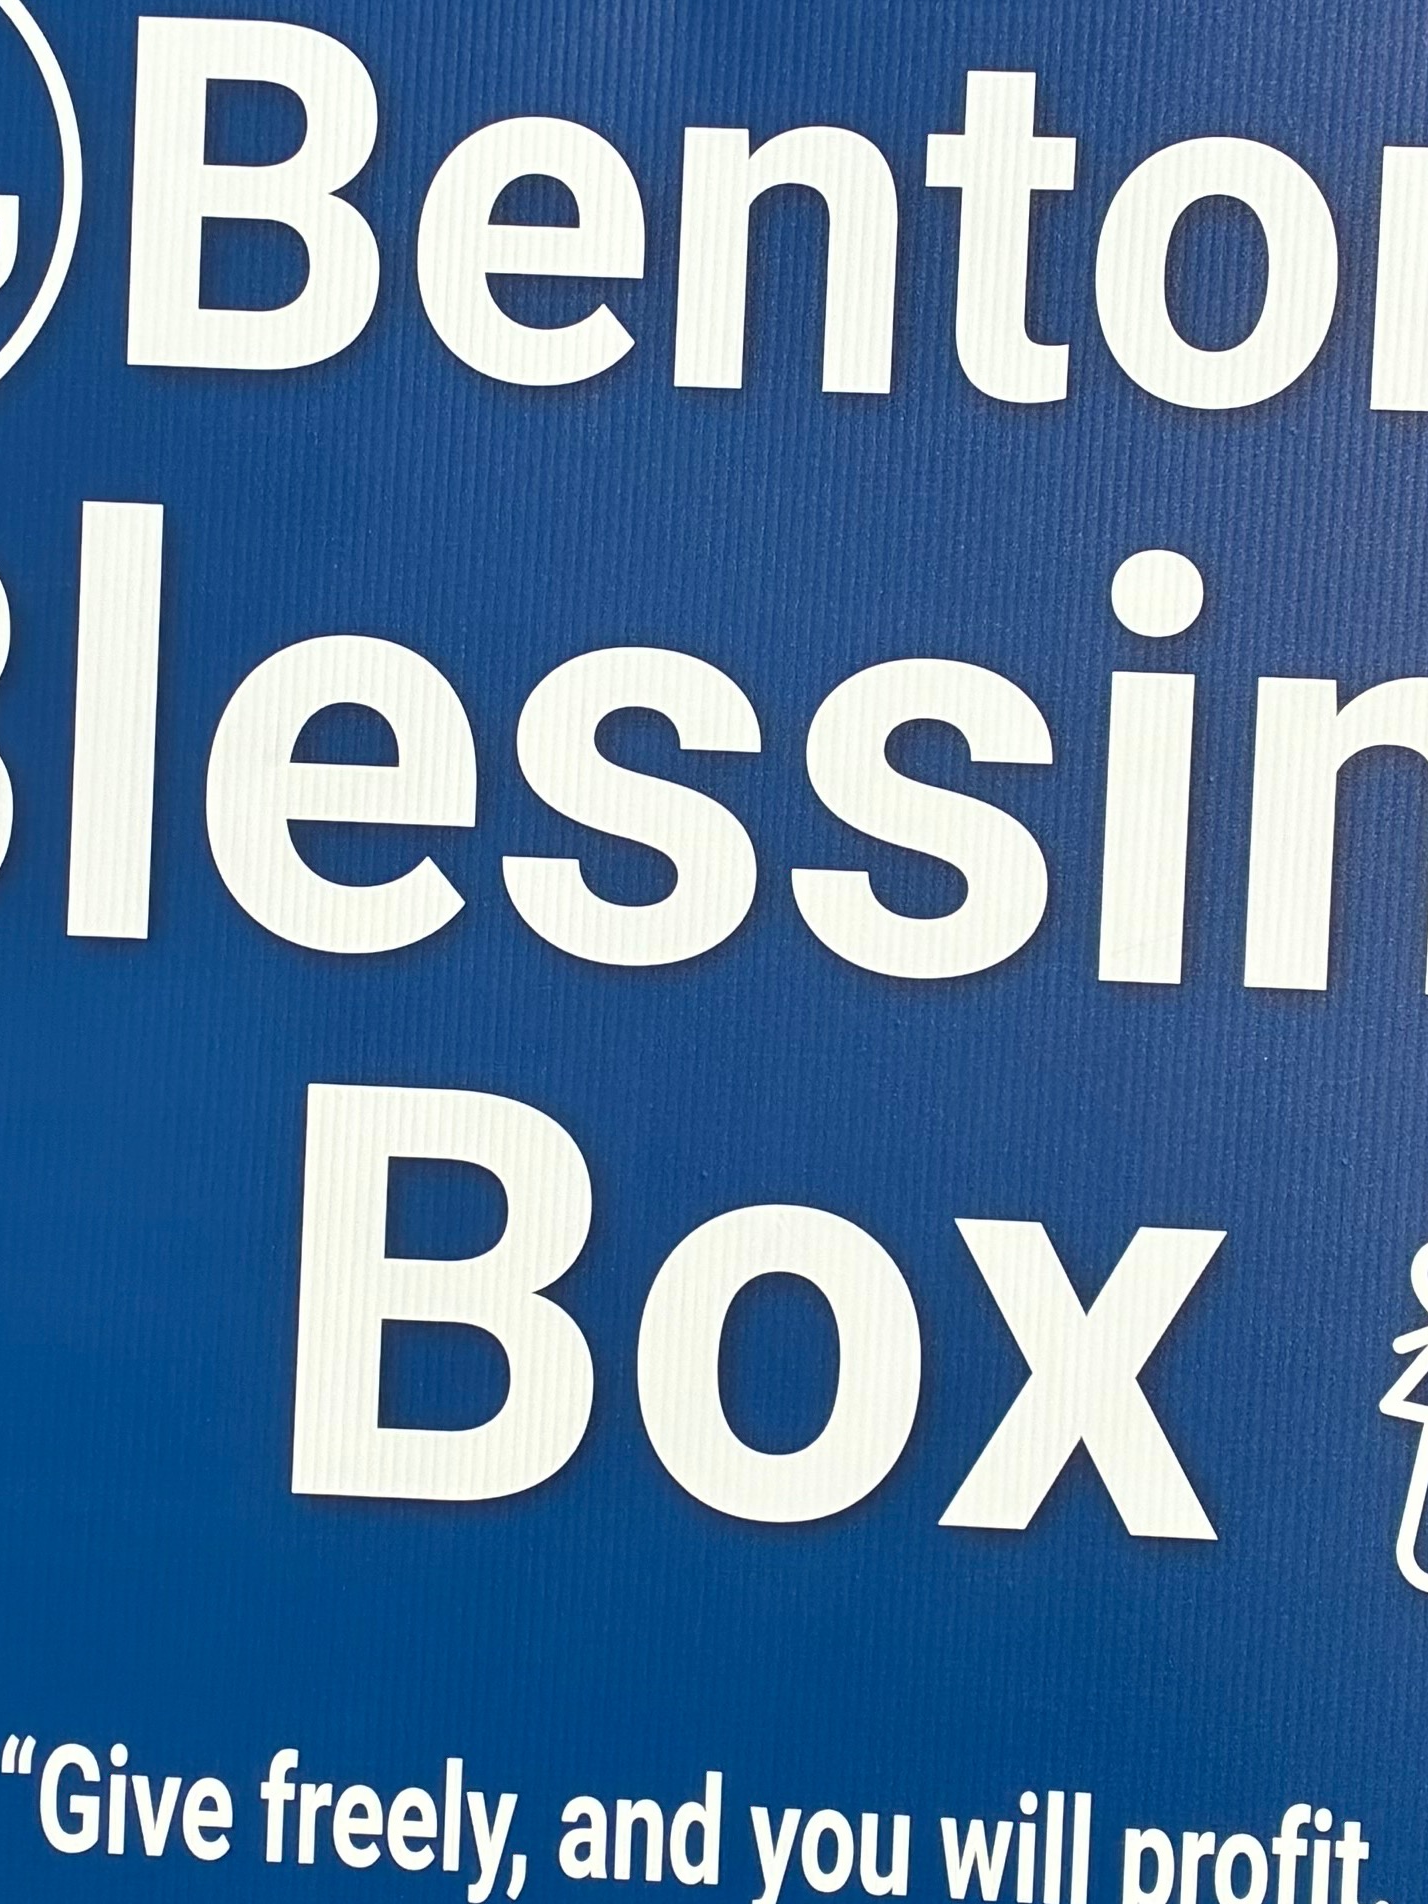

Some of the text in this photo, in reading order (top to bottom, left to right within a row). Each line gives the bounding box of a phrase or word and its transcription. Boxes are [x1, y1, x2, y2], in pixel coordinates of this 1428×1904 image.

[292, 1083, 1227, 1540] Box
[2, 1735, 232, 1862] “Give
[261, 1749, 526, 1903] freely,
[559, 1771, 722, 1884] and
